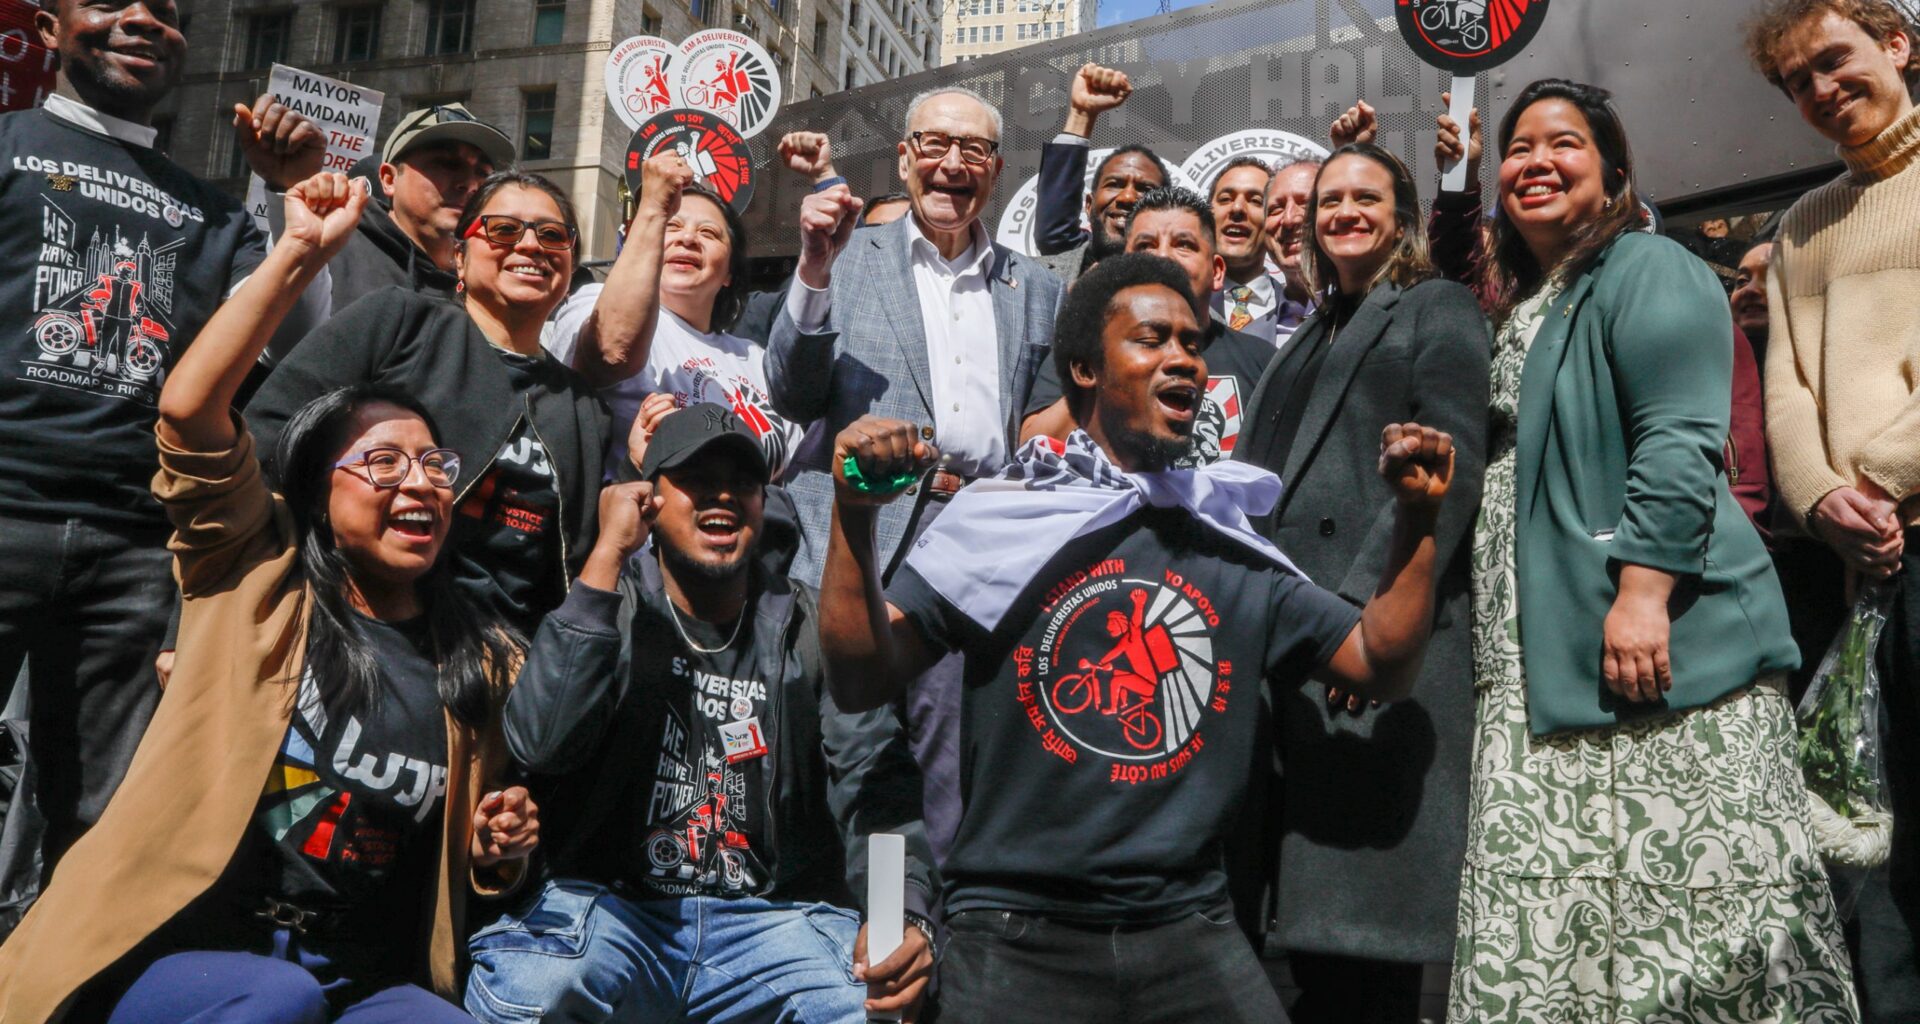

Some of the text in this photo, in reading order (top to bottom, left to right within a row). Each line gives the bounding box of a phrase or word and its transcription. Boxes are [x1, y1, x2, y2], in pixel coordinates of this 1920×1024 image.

[614, 53, 623, 64] AM
[626, 39, 666, 52] DELIVERISTA
[685, 42, 697, 53] AM
[696, 36, 702, 44] A
[702, 32, 748, 46] DELIVERISTA
[292, 75, 361, 106] MAYOR
[1013, 62, 1202, 129] CTY
[644, 123, 658, 137] AM
[674, 113, 704, 124] YO SOY
[330, 130, 365, 152] THE
[322, 152, 358, 172] ORE
[1187, 136, 1314, 181] ELIVERISTA
[13, 155, 205, 223] LOS DELIVERISTAS
[79, 182, 161, 219] UNIDOS
[43, 205, 69, 246] WE
[1008, 196, 1035, 234] LOS
[39, 243, 74, 268] HAVE
[33, 265, 84, 313] POWER
[26, 366, 100, 388] ROADMAP
[103, 383, 114, 391] TO
[1088, 558, 1125, 578] WITH
[1082, 579, 1118, 598] UNIDOS
[1165, 569, 1220, 628] YO APOYO
[1041, 592, 1084, 653] DELIVERISTAS
[1039, 656, 1049, 675] LOS
[662, 713, 684, 759] WE
[656, 751, 687, 781] HAVE
[1110, 732, 1205, 785] JE SUIS AU CÔTÉ
[646, 779, 694, 826] POWER
[649, 881, 702, 896] OADMAP
